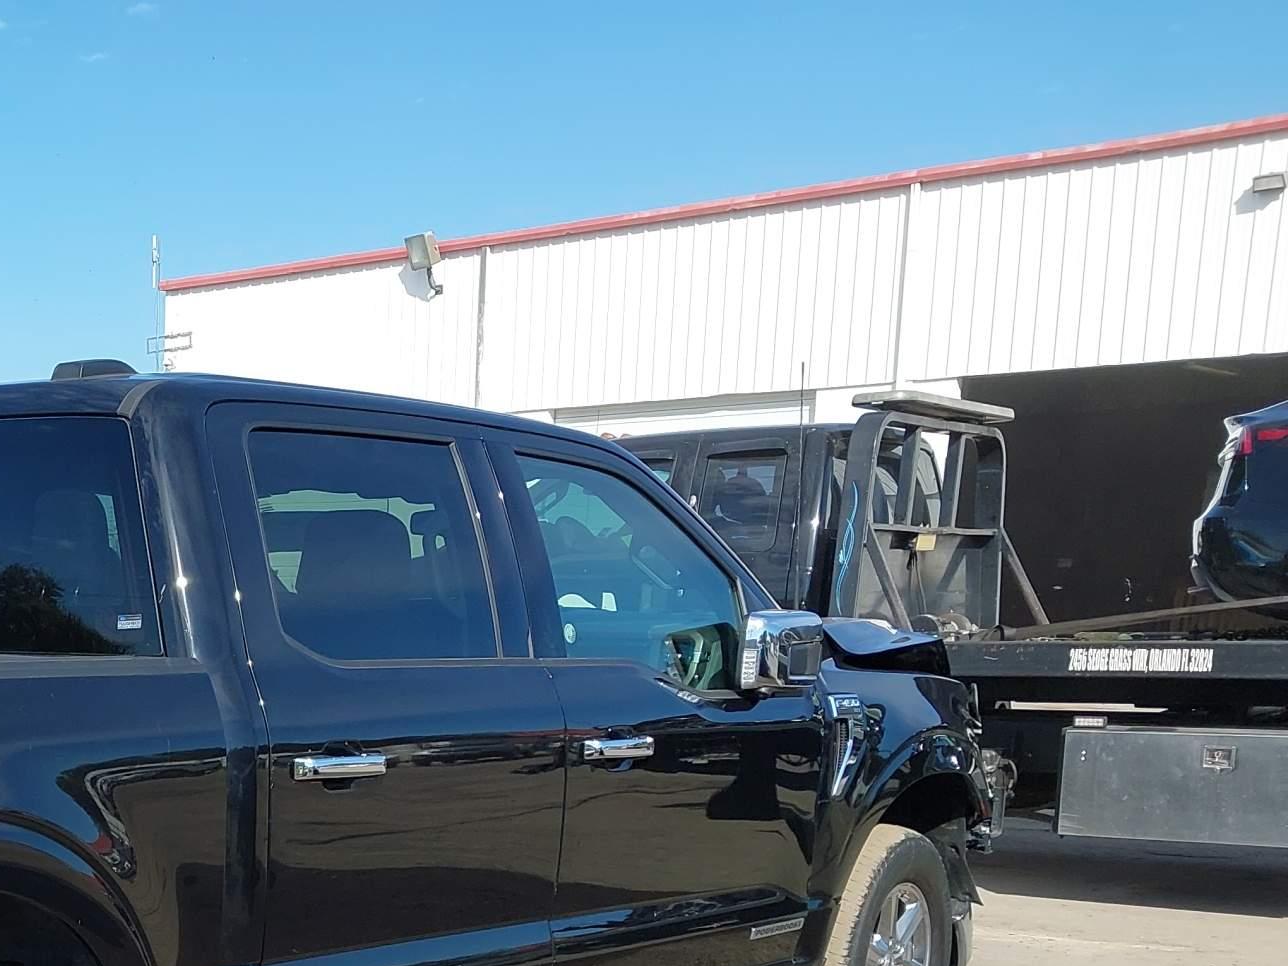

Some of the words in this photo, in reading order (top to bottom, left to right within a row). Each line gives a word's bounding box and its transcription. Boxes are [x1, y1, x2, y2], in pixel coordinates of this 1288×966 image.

[1068, 648, 1087, 671] 2456
[1087, 648, 1109, 671] SEDGE
[1109, 648, 1132, 671] GRASS
[1149, 648, 1181, 671] ORLANDO
[1181, 648, 1190, 672] FL
[1190, 648, 1213, 672] 32824
